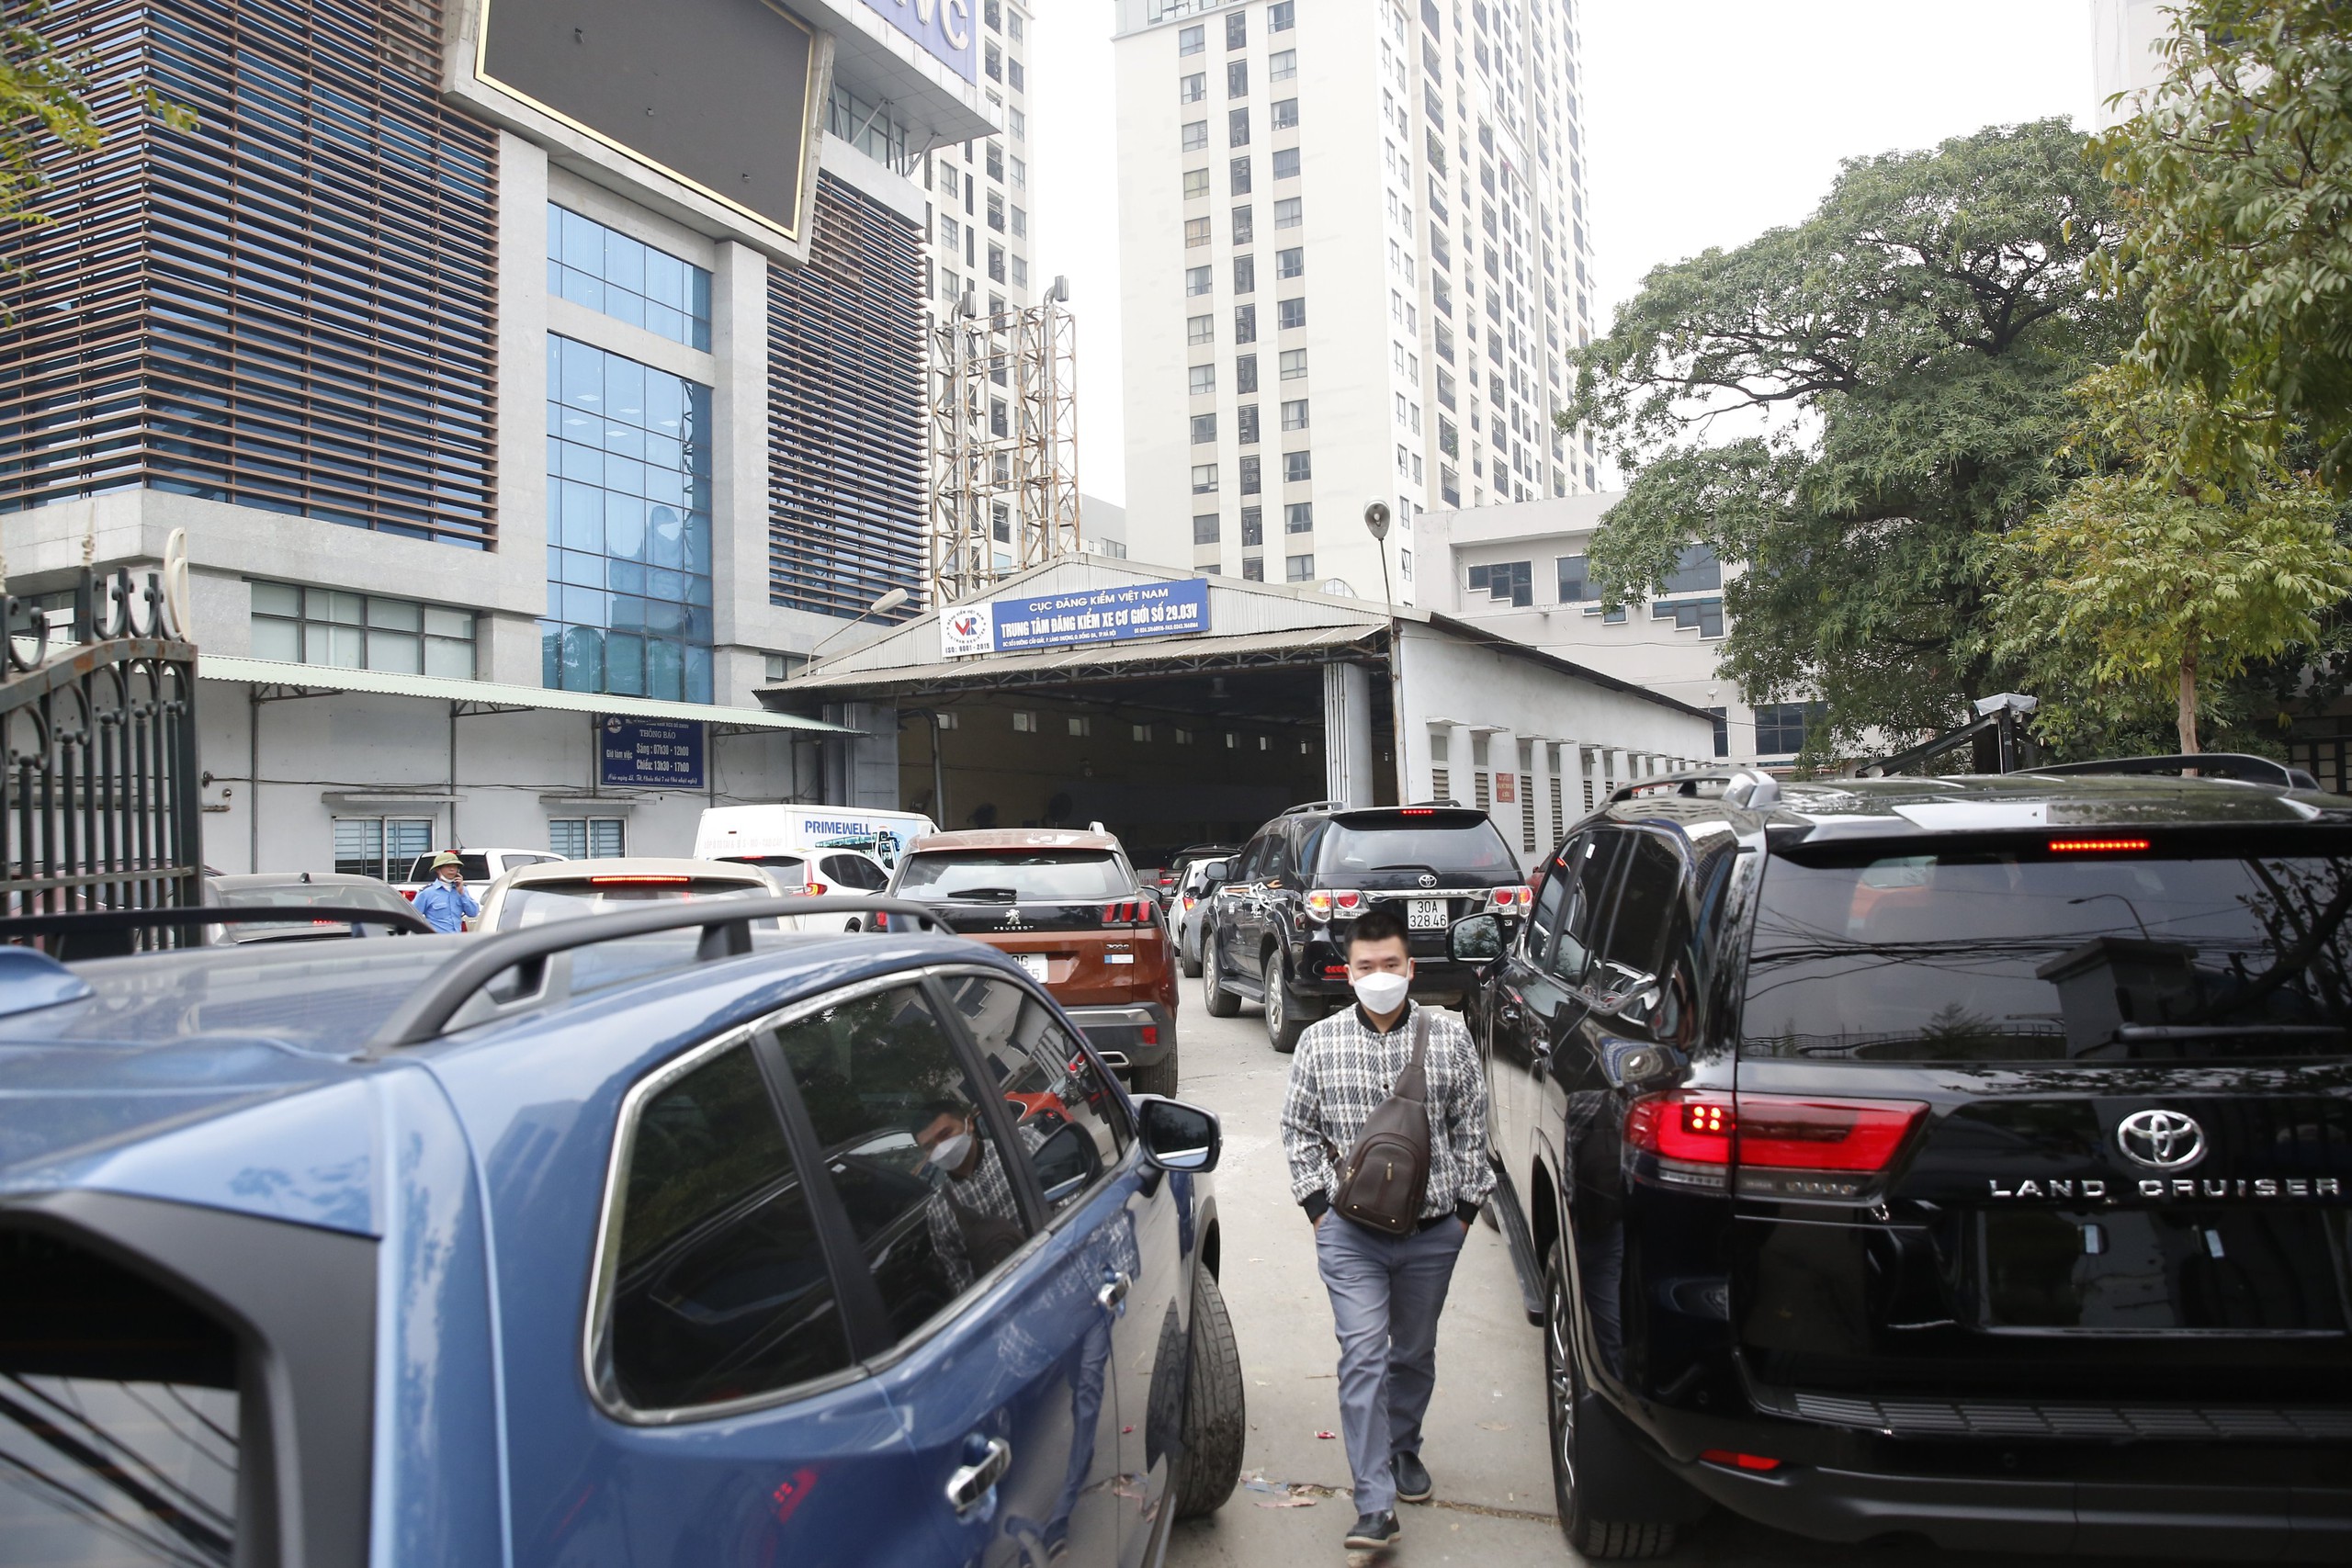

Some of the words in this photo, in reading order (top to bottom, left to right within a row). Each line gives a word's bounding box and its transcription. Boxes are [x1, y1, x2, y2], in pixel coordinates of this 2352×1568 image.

[1029, 602, 1052, 613] CỤC
[1056, 598, 1088, 609] ĐĂNG
[1091, 591, 1115, 604] KIỂM
[1118, 591, 1138, 603] VIỆT
[1142, 588, 1169, 599] NAM
[1001, 621, 1029, 637] TRUNG
[1031, 617, 1049, 635] TÂM
[1051, 615, 1076, 632] ĐĂNG
[1077, 607, 1100, 630] KIỂM
[1102, 612, 1114, 627] XE
[1115, 609, 1128, 626] CƠ
[1131, 604, 1149, 625] GIỚI
[1151, 601, 1164, 623] SỐ
[1166, 603, 1198, 621] 29.03V
[639, 728, 662, 738] THÔNG
[663, 729, 676, 739] BÁO
[653, 744, 669, 755] 07h30
[674, 746, 689, 756] 12h00
[654, 761, 669, 771] 13h30
[674, 762, 689, 773] 17h00
[805, 820, 871, 835] PRIMEWELL
[1418, 901, 1438, 913] 30A
[1410, 914, 1446, 927] 328.46
[1989, 1179, 2106, 1197] LAND
[2138, 1178, 2340, 1197] CRUISER
